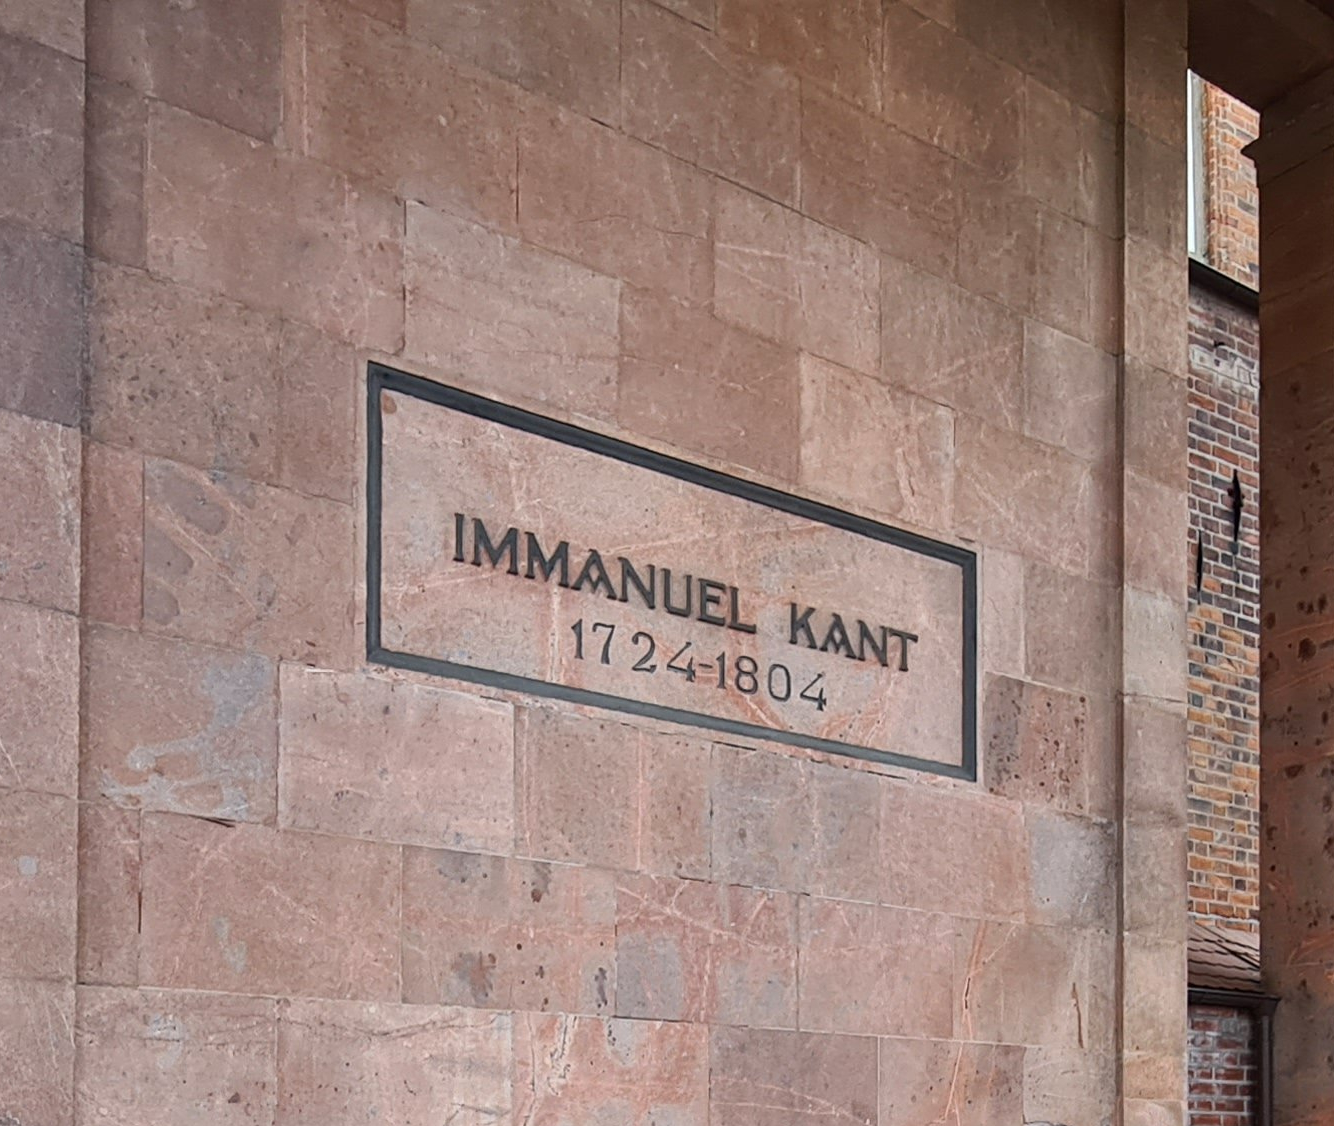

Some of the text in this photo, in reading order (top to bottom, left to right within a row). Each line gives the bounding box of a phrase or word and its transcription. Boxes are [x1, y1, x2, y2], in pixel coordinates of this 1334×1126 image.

[453, 513, 918, 671] IMMANUEL KANT
[571, 618, 827, 711] 1724-1804
